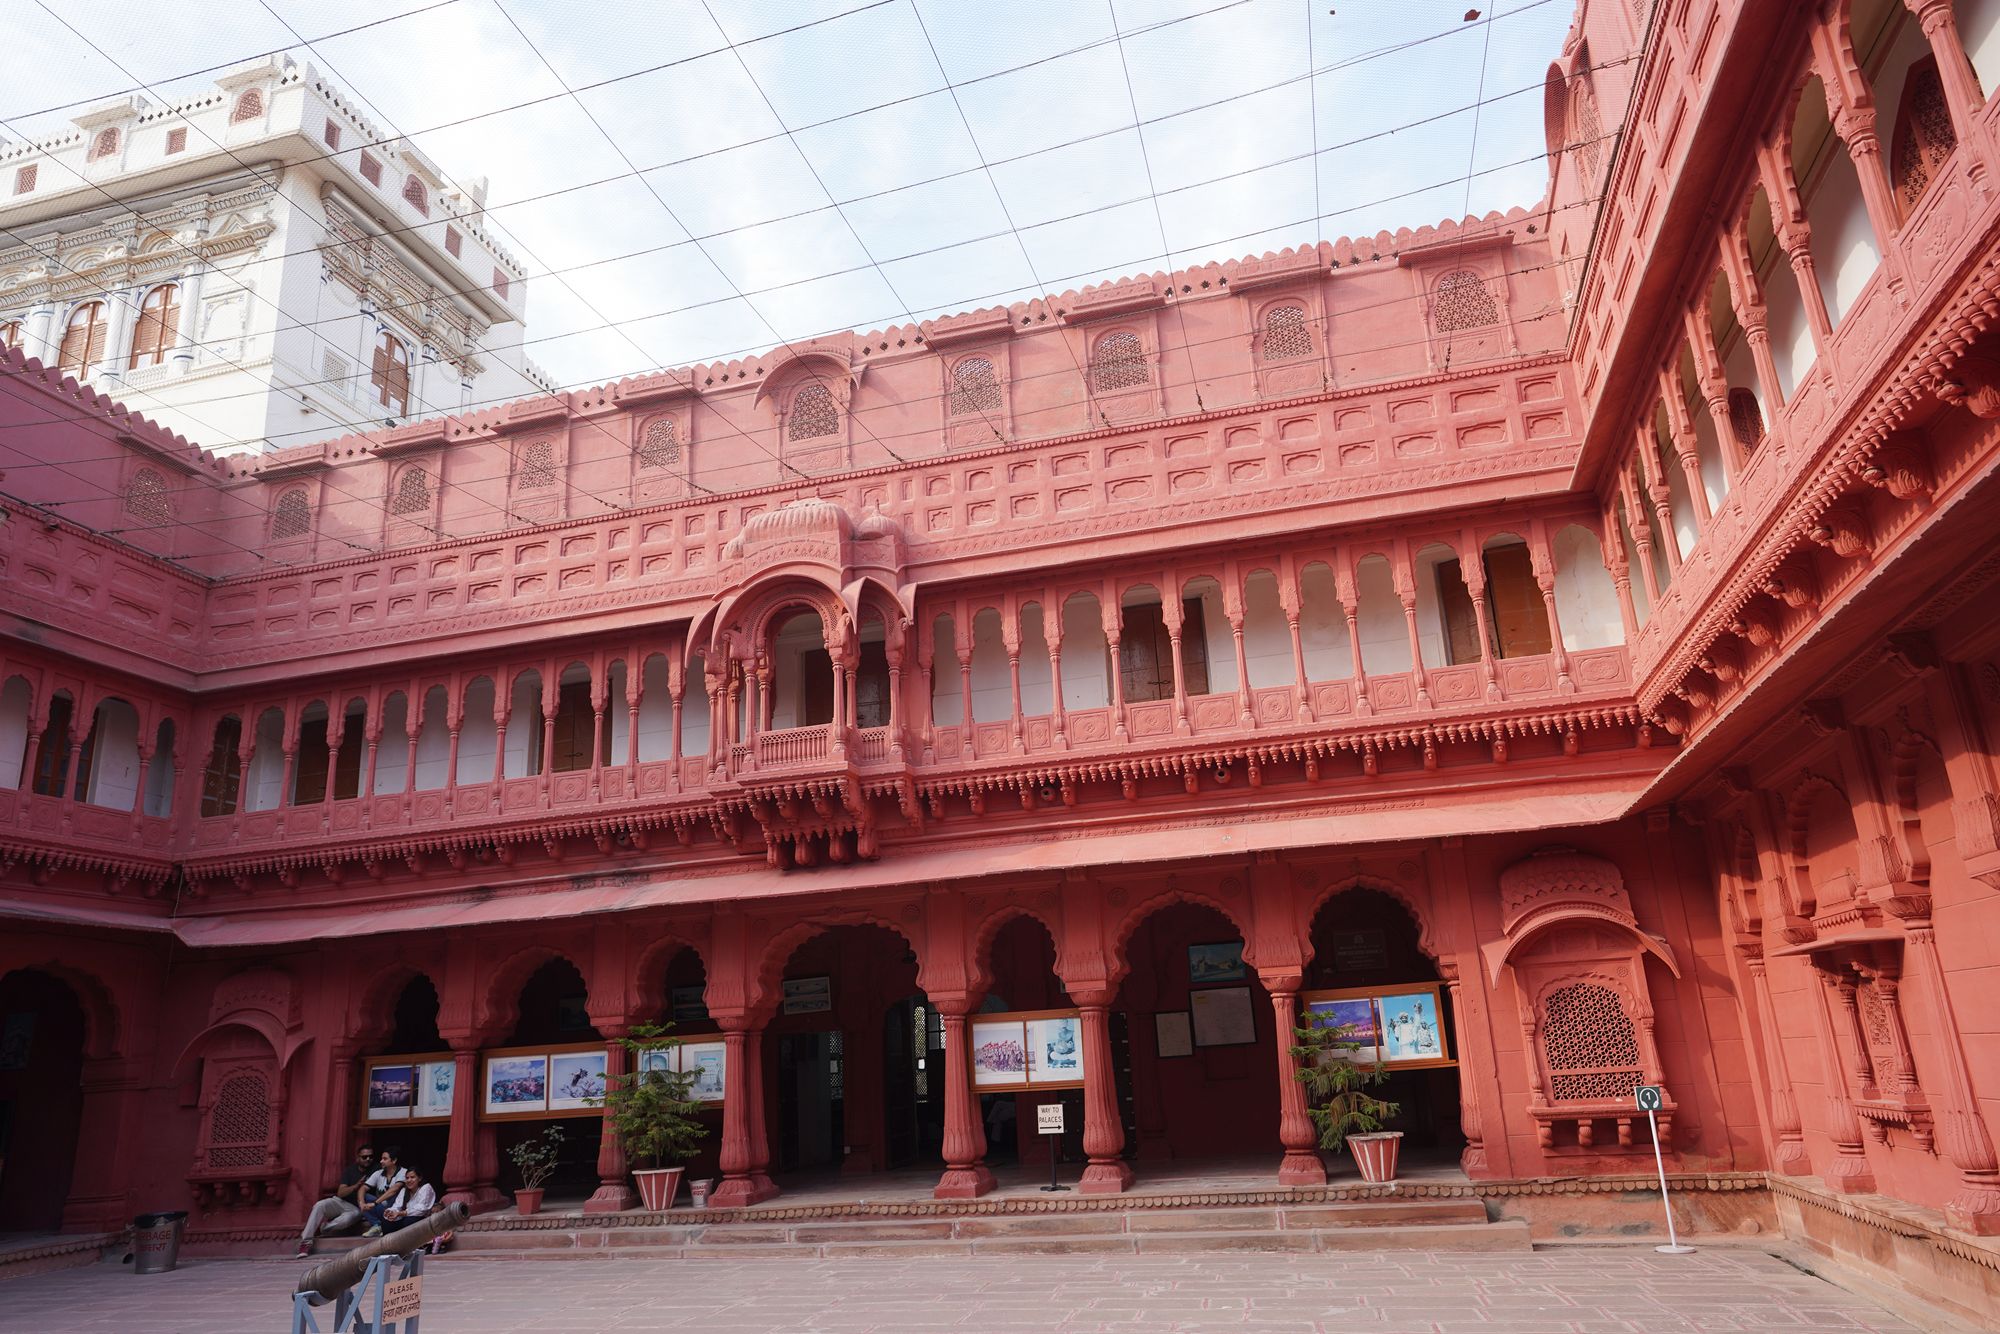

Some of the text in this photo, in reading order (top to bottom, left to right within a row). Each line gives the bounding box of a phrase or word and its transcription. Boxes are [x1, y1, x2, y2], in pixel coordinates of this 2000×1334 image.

[1646, 1092, 1651, 1100] 1
[390, 1283, 413, 1295] PLEASE
[384, 1292, 419, 1309] DO NOT TOUCH
